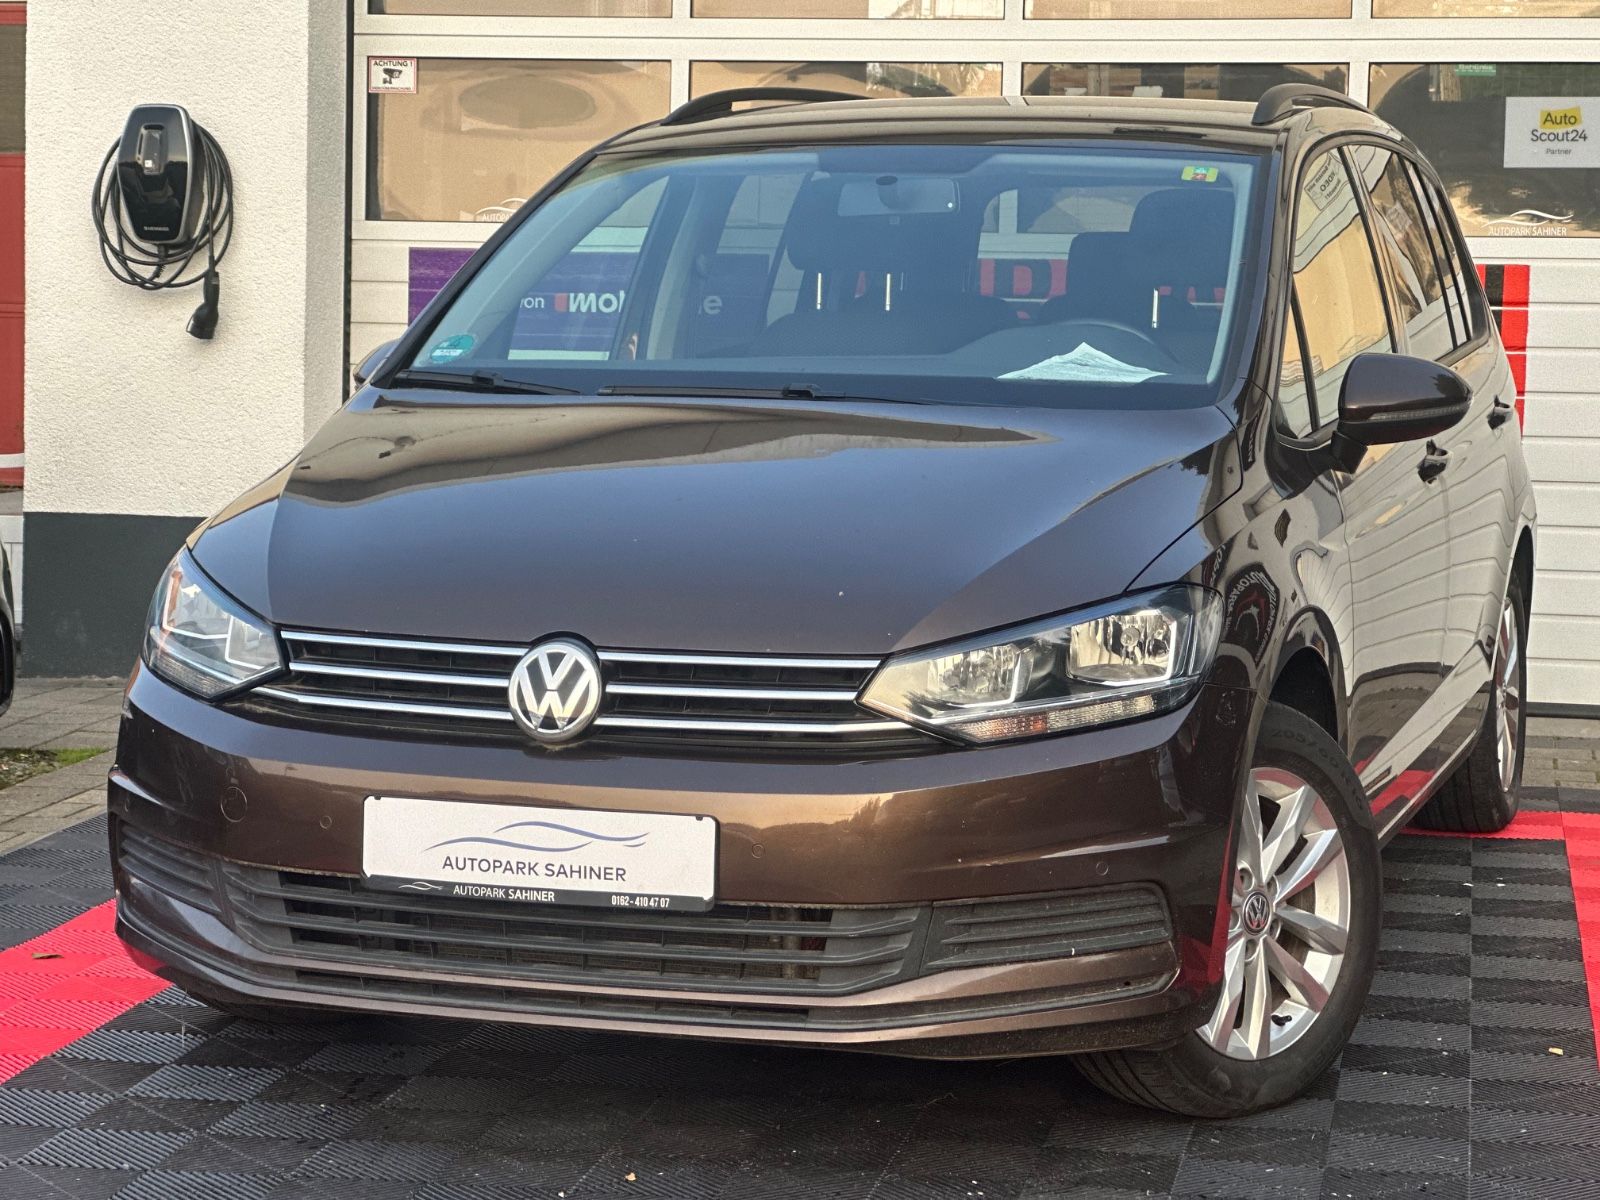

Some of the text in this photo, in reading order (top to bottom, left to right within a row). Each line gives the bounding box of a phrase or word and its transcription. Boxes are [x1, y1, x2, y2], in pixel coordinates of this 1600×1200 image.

[1543, 112, 1578, 125] Auto
[1530, 128, 1588, 142] Scout24
[1488, 226, 1567, 236] AUTOPARK SAHINER
[442, 856, 628, 882] AUTOPARK SAHINER
[453, 884, 556, 902] AUTOPARK SAHINER
[649, 897, 659, 907] 47
[660, 898, 670, 908] 07
